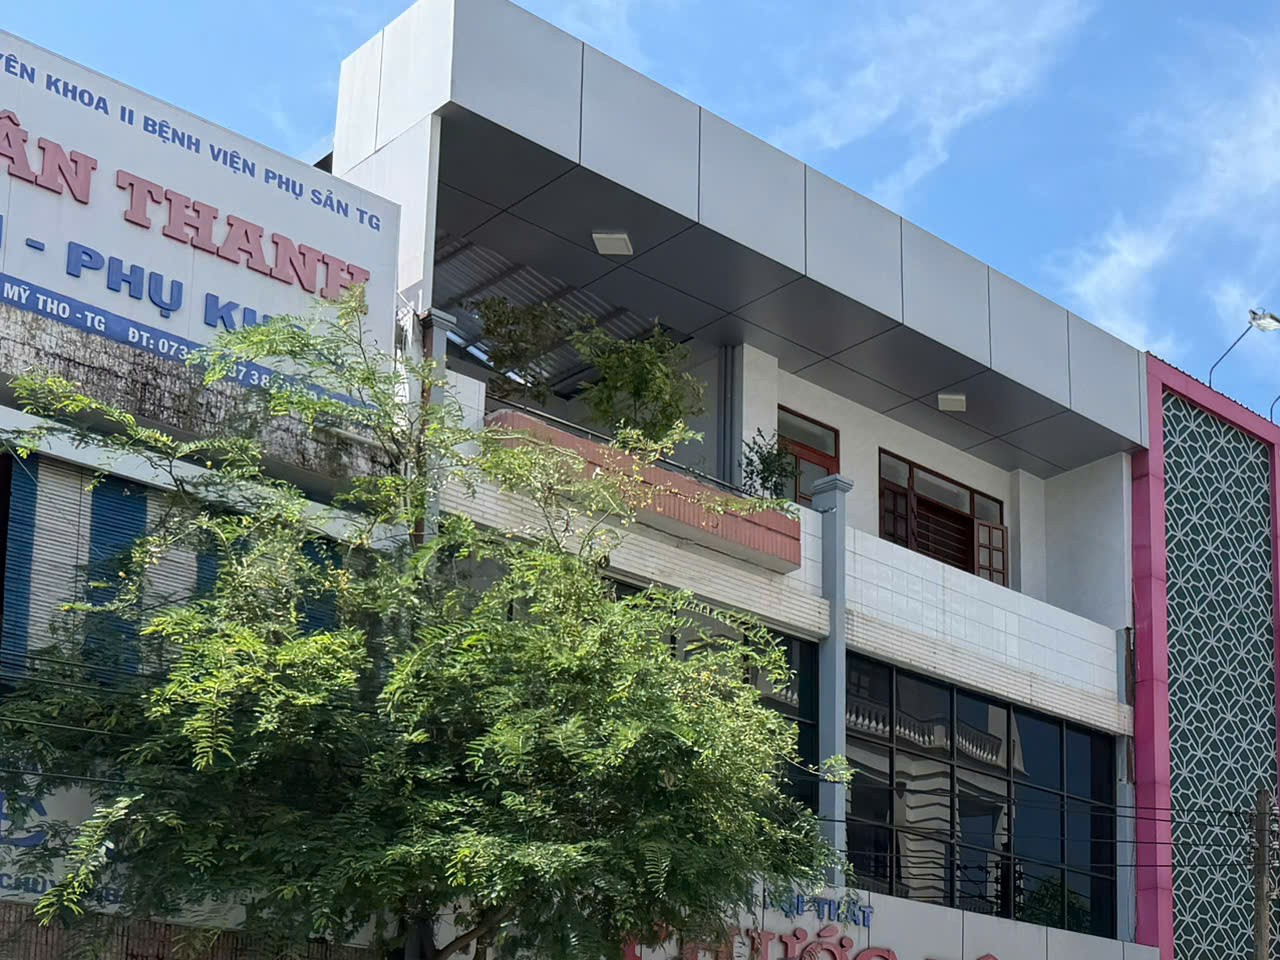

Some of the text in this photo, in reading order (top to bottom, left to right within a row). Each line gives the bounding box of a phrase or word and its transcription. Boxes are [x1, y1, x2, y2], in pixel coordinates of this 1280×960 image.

[0, 53, 35, 84] ÊN
[46, 73, 109, 116] KHOA
[143, 115, 200, 154] BỆNH
[209, 143, 255, 177] VIỆN
[264, 167, 303, 200] PHỤ
[310, 189, 349, 218] SẢN
[356, 207, 381, 232] TG
[66, 241, 183, 318] PHỤ
[116, 169, 371, 301] THANH
[4, 282, 30, 304] MỸ
[36, 293, 70, 319] THO
[128, 326, 154, 349] ĐT:
